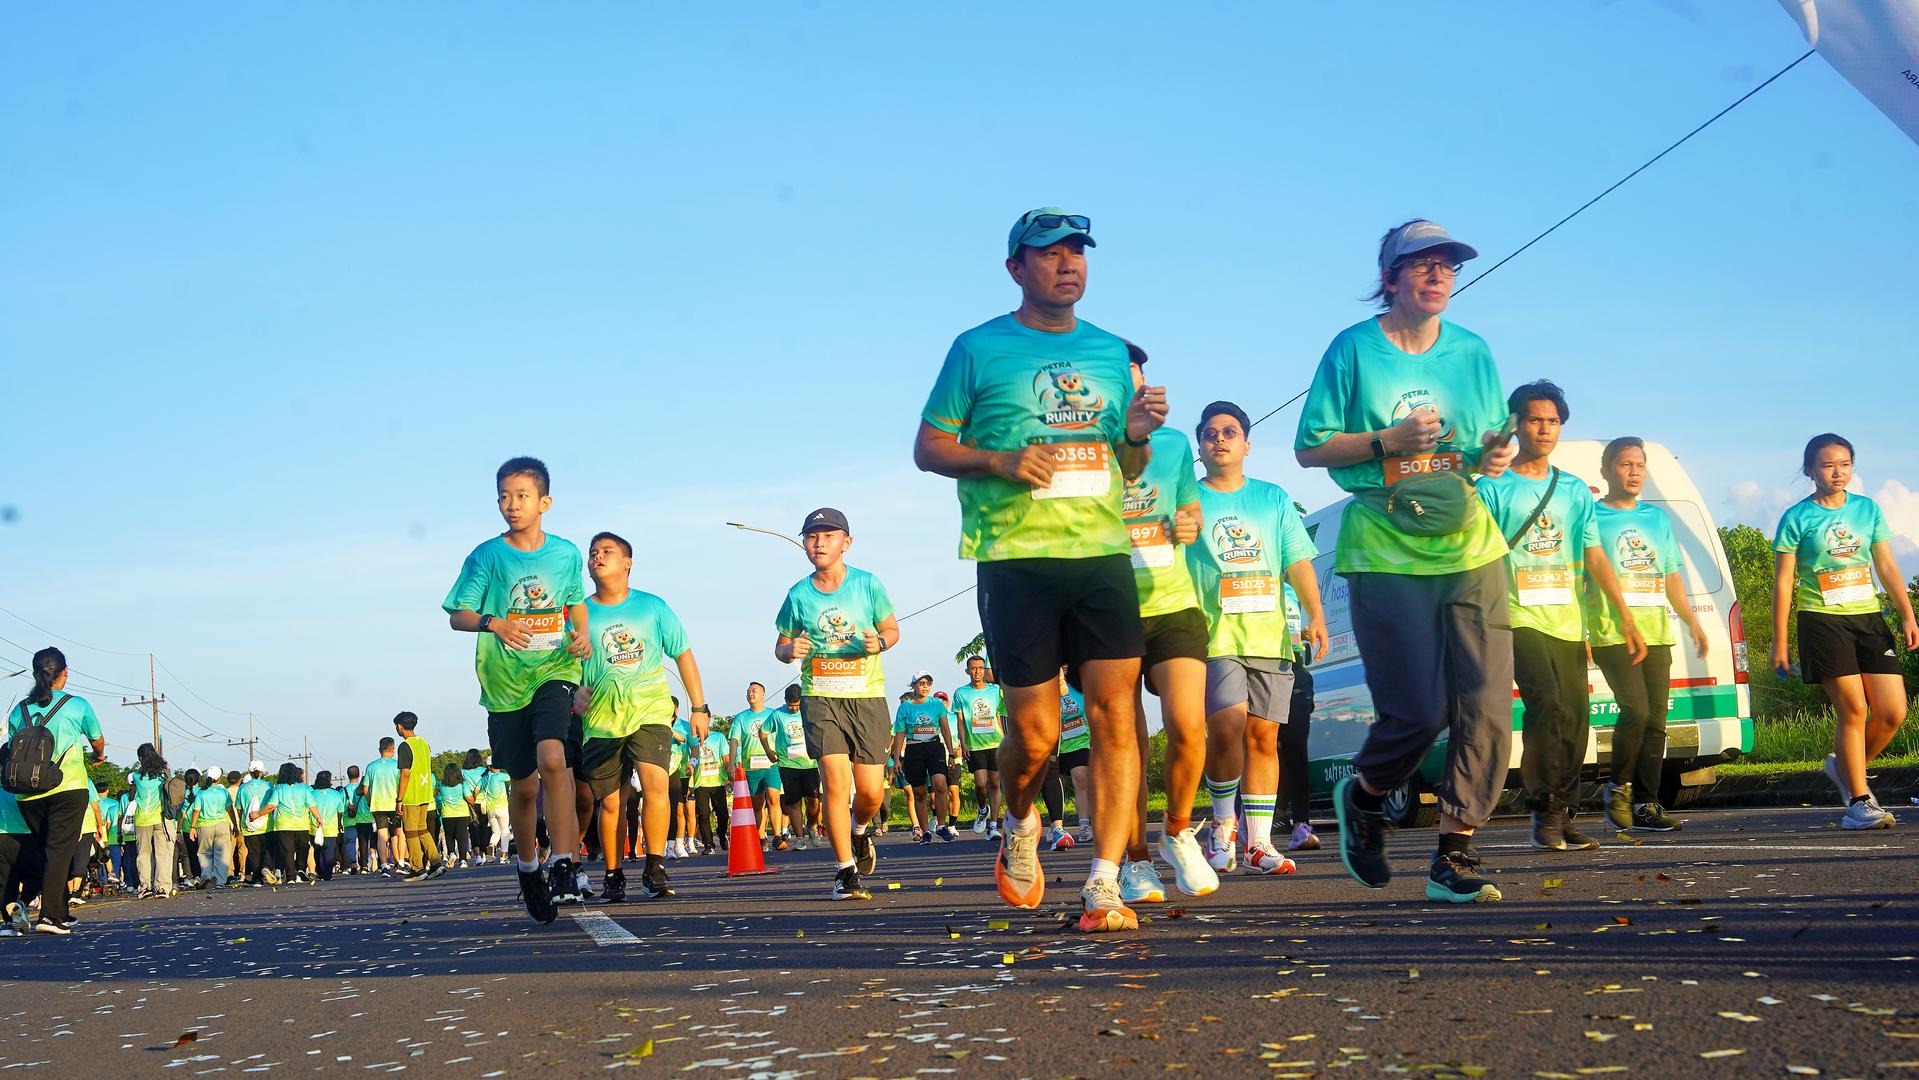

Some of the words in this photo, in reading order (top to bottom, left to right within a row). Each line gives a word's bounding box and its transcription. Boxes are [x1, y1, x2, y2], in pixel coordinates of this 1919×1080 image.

[1042, 361, 1072, 372] PETRA
[1402, 389, 1429, 401] PETRA
[1046, 410, 1095, 424] RUNITY
[1053, 446, 1097, 462] 0365
[1400, 458, 1451, 474] 50795
[1122, 500, 1150, 512] UNITY
[1218, 515, 1239, 525] PETRA
[1128, 526, 1159, 540] 897
[1223, 549, 1258, 561] RUNITY
[1623, 558, 1651, 568] RUNITY
[519, 575, 538, 584] PETRA
[1232, 580, 1266, 590] 51023
[1692, 605, 1713, 613] DREN
[612, 651, 640, 662] RUNITY
[821, 661, 857, 670] 50002
[1590, 703, 1607, 715] ST
